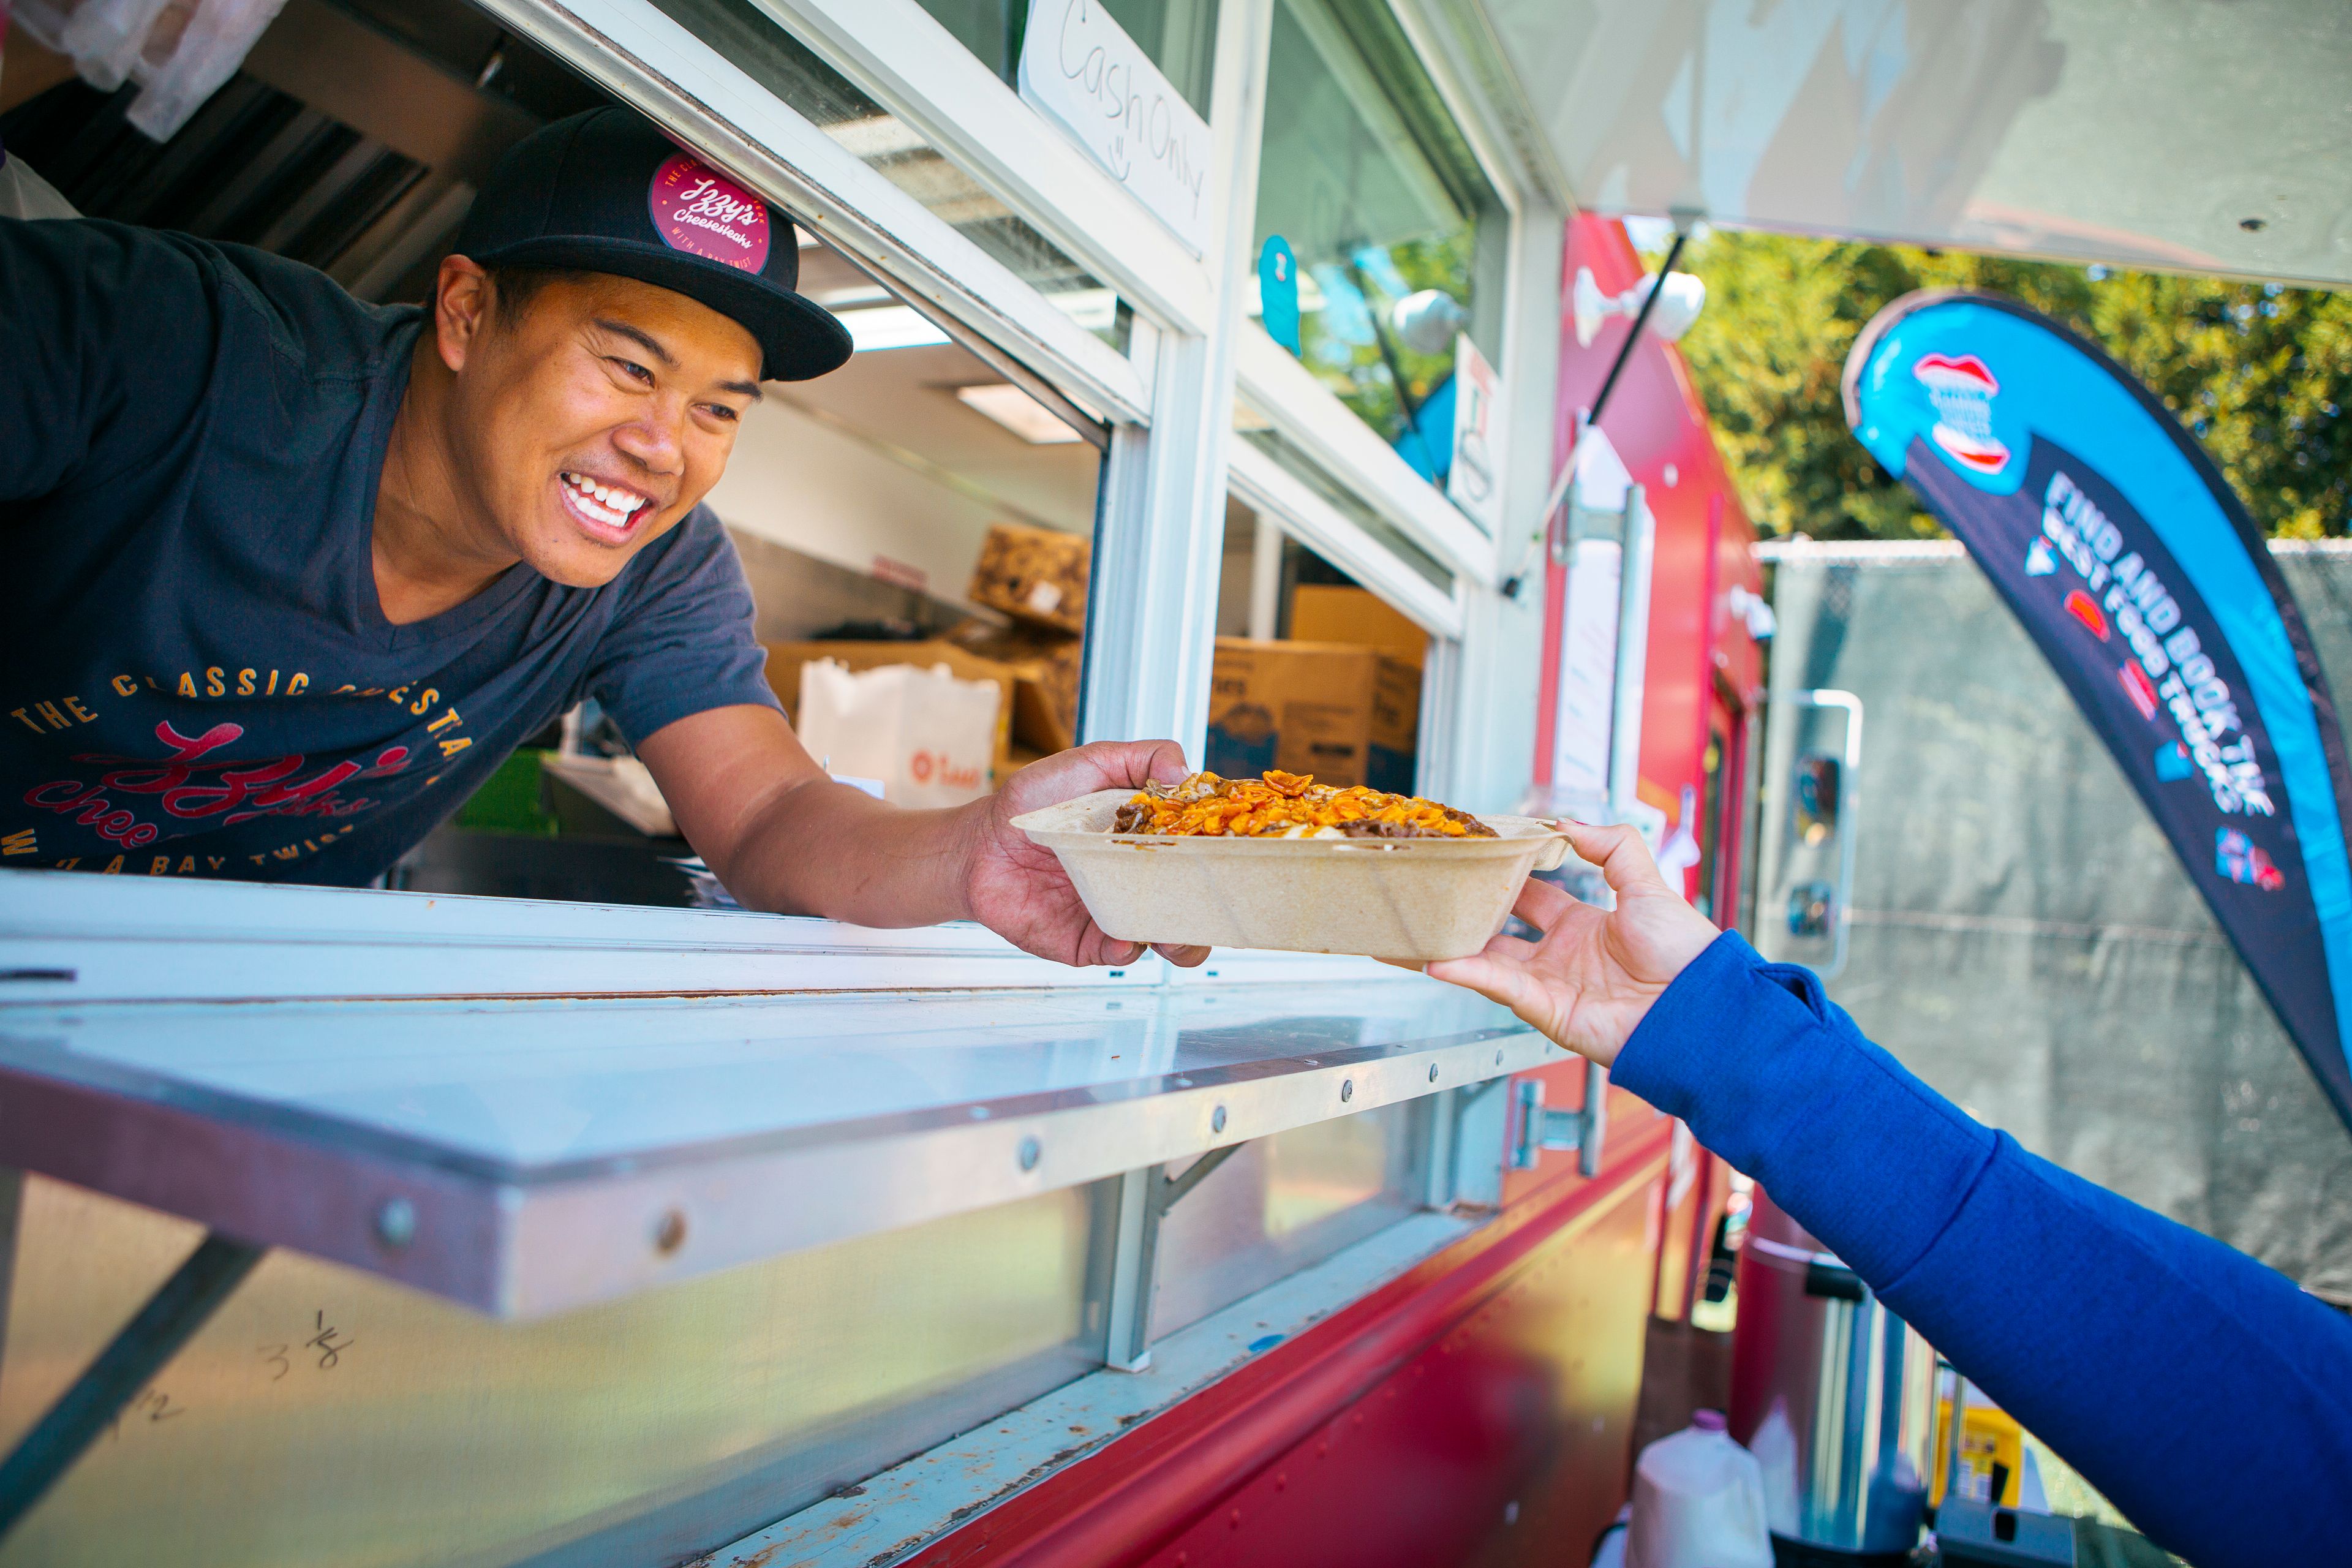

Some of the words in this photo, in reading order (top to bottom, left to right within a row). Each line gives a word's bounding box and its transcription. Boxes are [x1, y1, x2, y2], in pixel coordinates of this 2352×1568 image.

[1060, 0, 1144, 143] Cash
[1150, 94, 1204, 220] Only
[665, 170, 682, 187] THE
[679, 178, 759, 226] Izzy's
[671, 226, 695, 249] WITH
[696, 247, 704, 256] A
[673, 208, 753, 249] Cheesesteaks
[2045, 470, 2123, 564] FIND
[2111, 551, 2181, 636] AND
[2163, 625, 2242, 741] BOOK
[2041, 506, 2111, 592] BEST
[2103, 582, 2170, 679] FOOD
[2158, 670, 2244, 813] TRUCKS
[10, 696, 99, 734] THE
[150, 855, 225, 876] BAY
